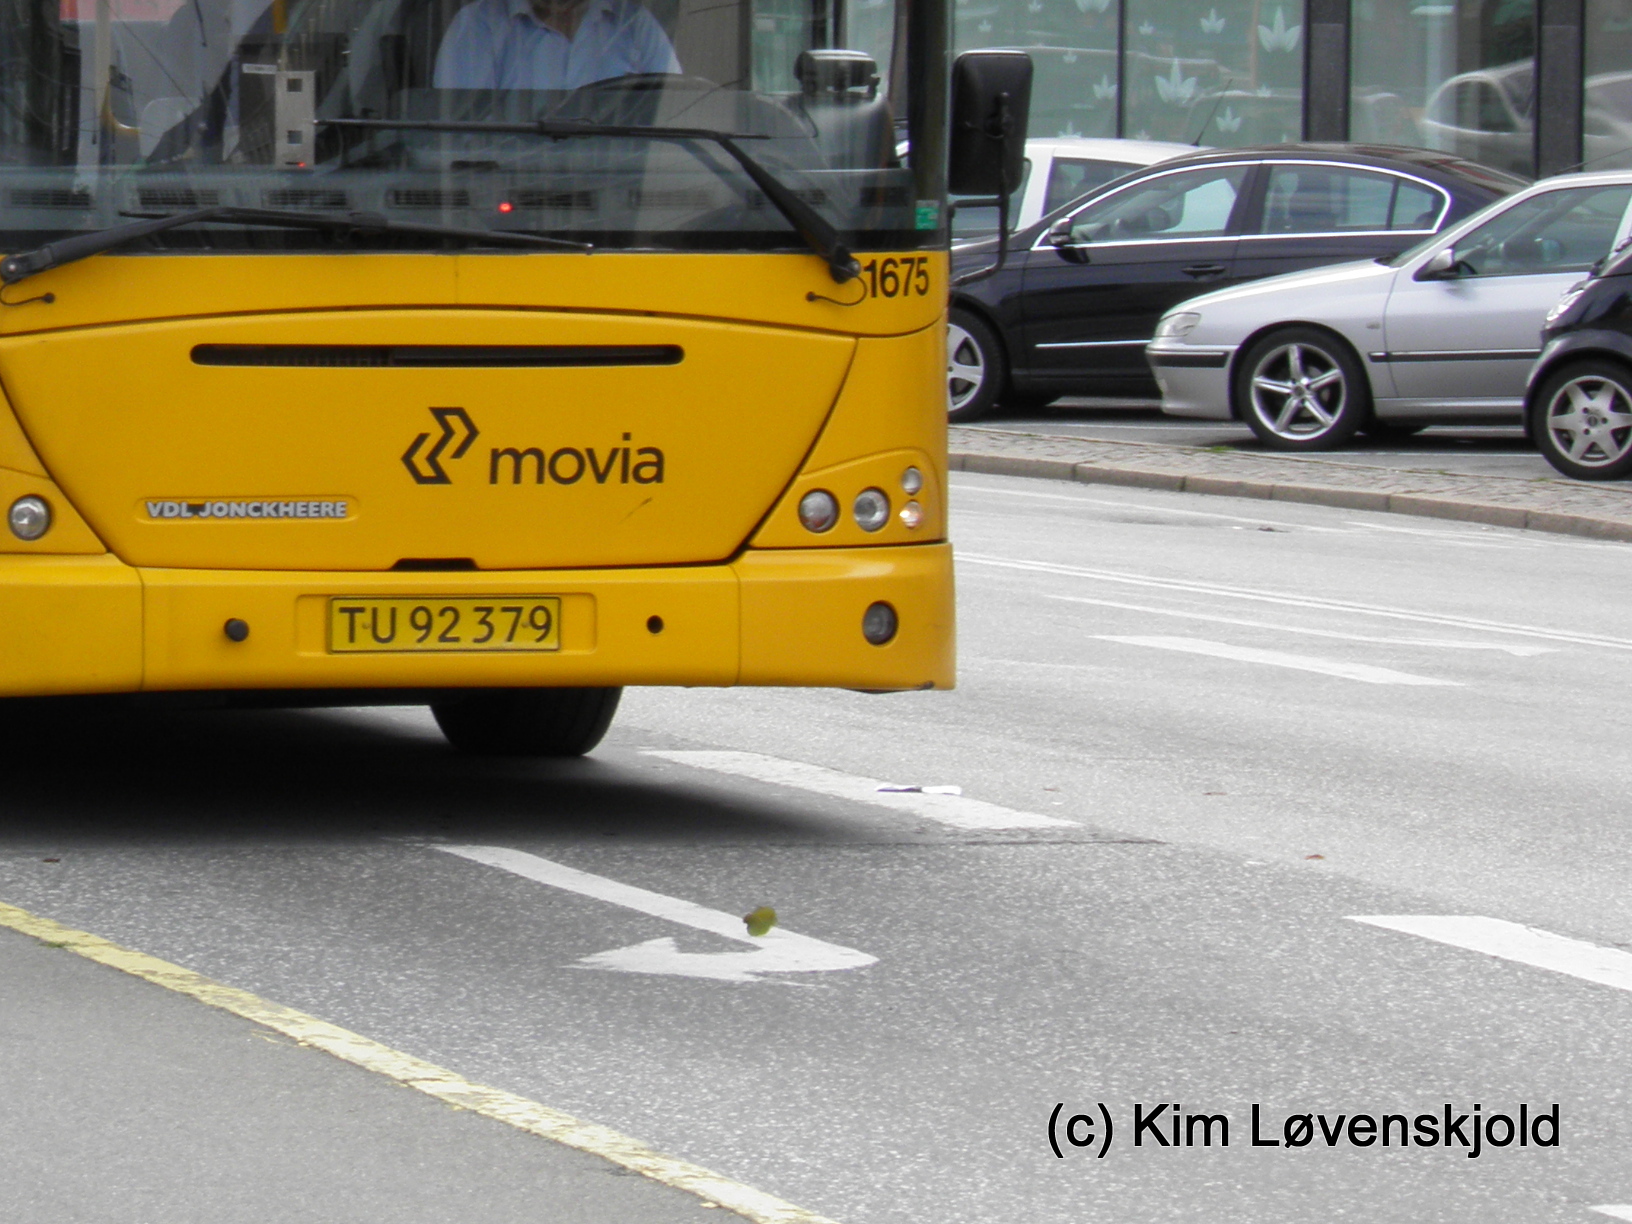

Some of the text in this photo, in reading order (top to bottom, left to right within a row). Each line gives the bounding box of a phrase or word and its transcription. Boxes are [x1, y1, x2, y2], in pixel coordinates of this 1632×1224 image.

[863, 257, 929, 298] 1675
[489, 432, 665, 484] movia
[145, 501, 347, 518] VDL JONCKHEERE
[338, 605, 553, 644] TU 92 379
